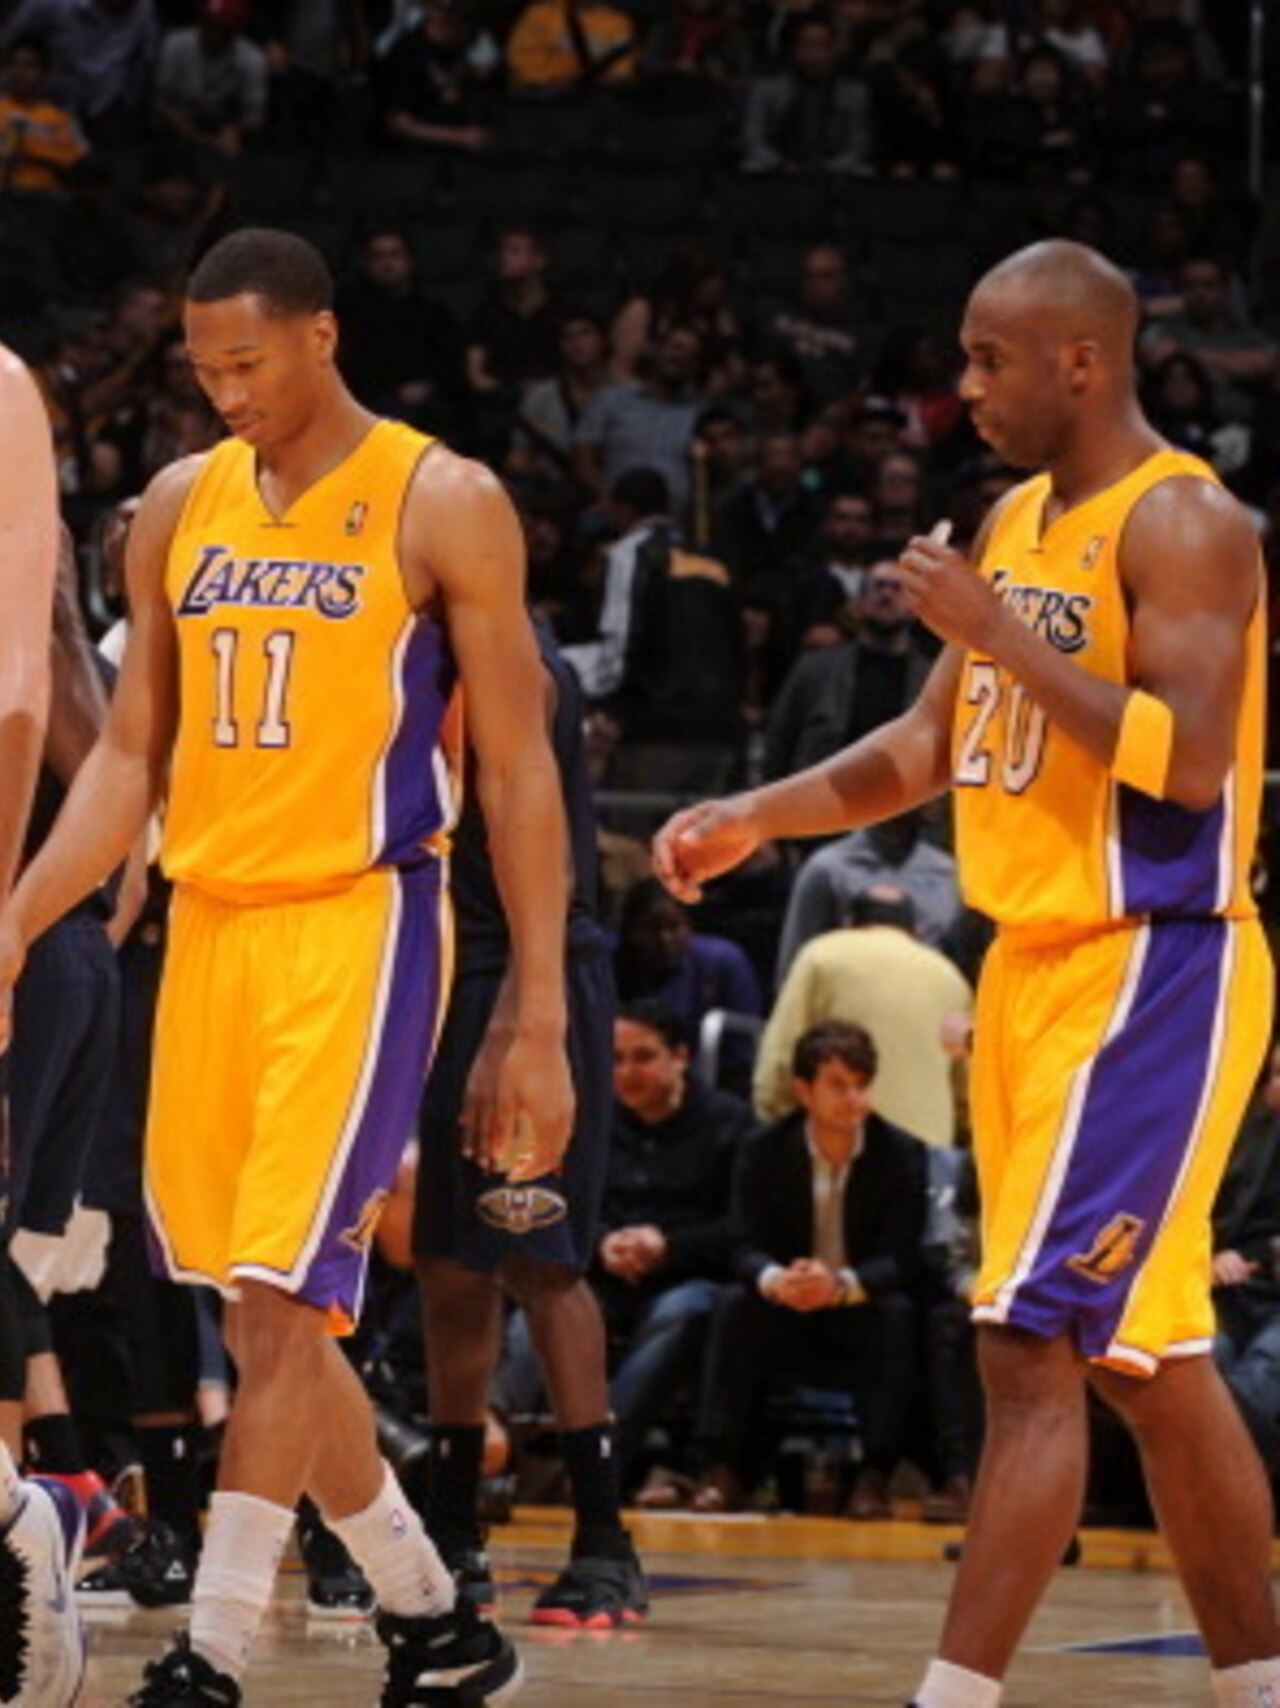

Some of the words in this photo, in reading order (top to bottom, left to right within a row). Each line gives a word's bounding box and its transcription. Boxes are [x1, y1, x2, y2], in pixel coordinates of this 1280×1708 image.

[175, 545, 367, 622] LAKERS
[211, 626, 296, 749] 11
[954, 660, 1047, 796] 20
